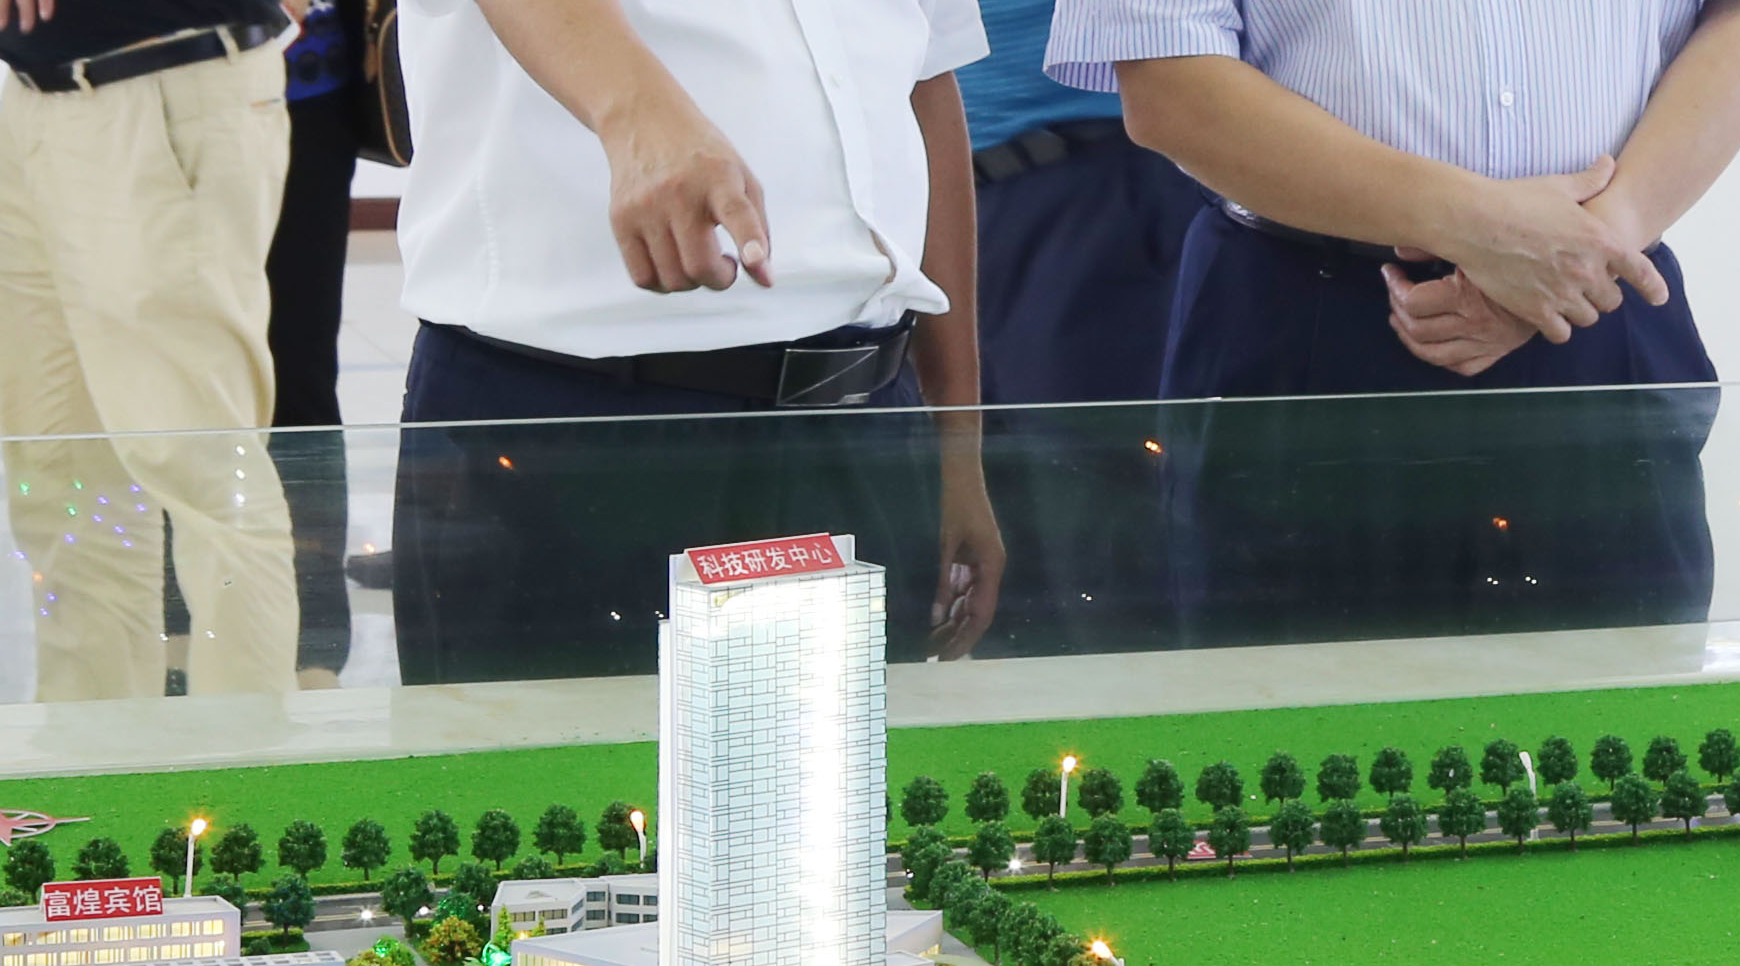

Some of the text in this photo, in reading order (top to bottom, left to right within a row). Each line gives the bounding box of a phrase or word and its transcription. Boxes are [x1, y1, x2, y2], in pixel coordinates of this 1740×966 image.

[696, 542, 833, 579] 科技研发中心
[44, 885, 162, 918] 富煌宾馆
